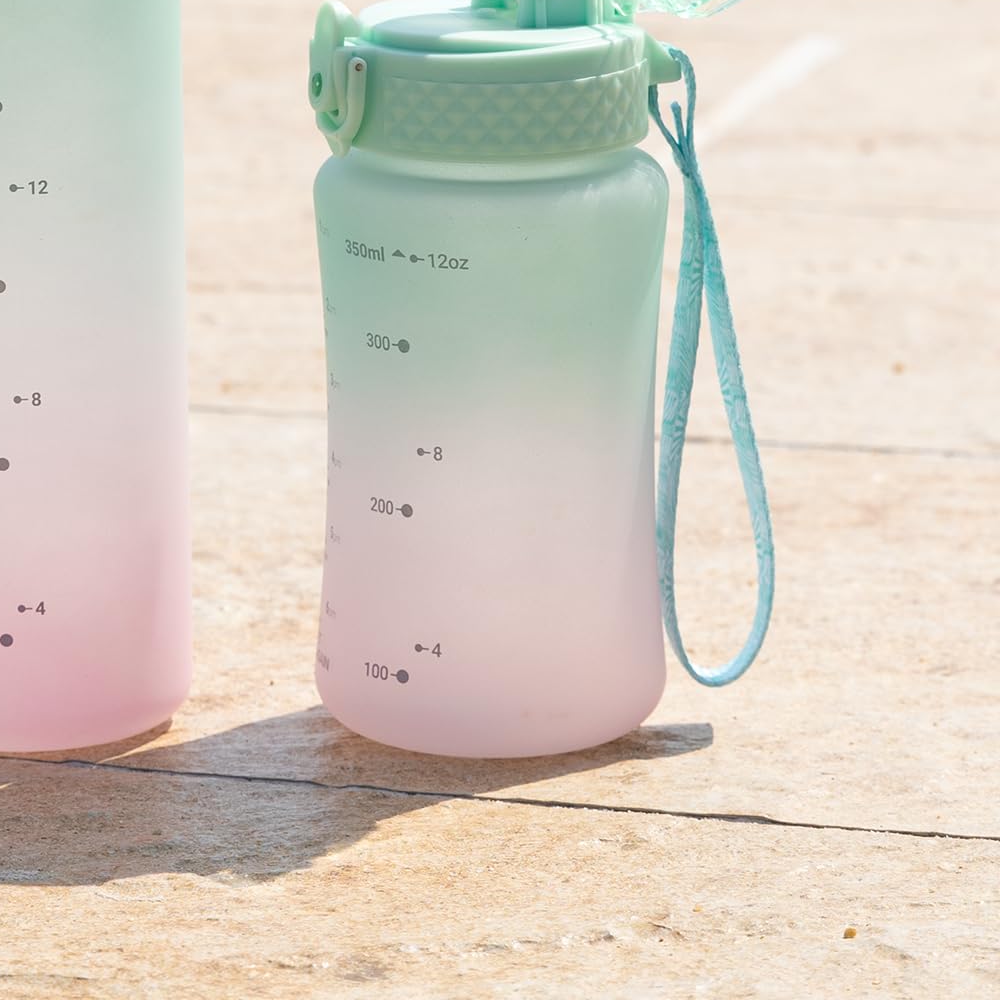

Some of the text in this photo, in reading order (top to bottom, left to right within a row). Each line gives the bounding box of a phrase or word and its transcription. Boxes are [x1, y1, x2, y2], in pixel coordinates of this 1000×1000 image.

[27, 180, 49, 195] 12
[344, 239, 385, 262] 350ml
[427, 253, 469, 270] 12oz
[366, 332, 391, 351] 300
[31, 392, 42, 406] 8
[433, 446, 443, 462] 8
[370, 497, 394, 515] 200
[35, 601, 46, 615] 4
[431, 642, 442, 658] 4
[364, 662, 389, 681] 100
